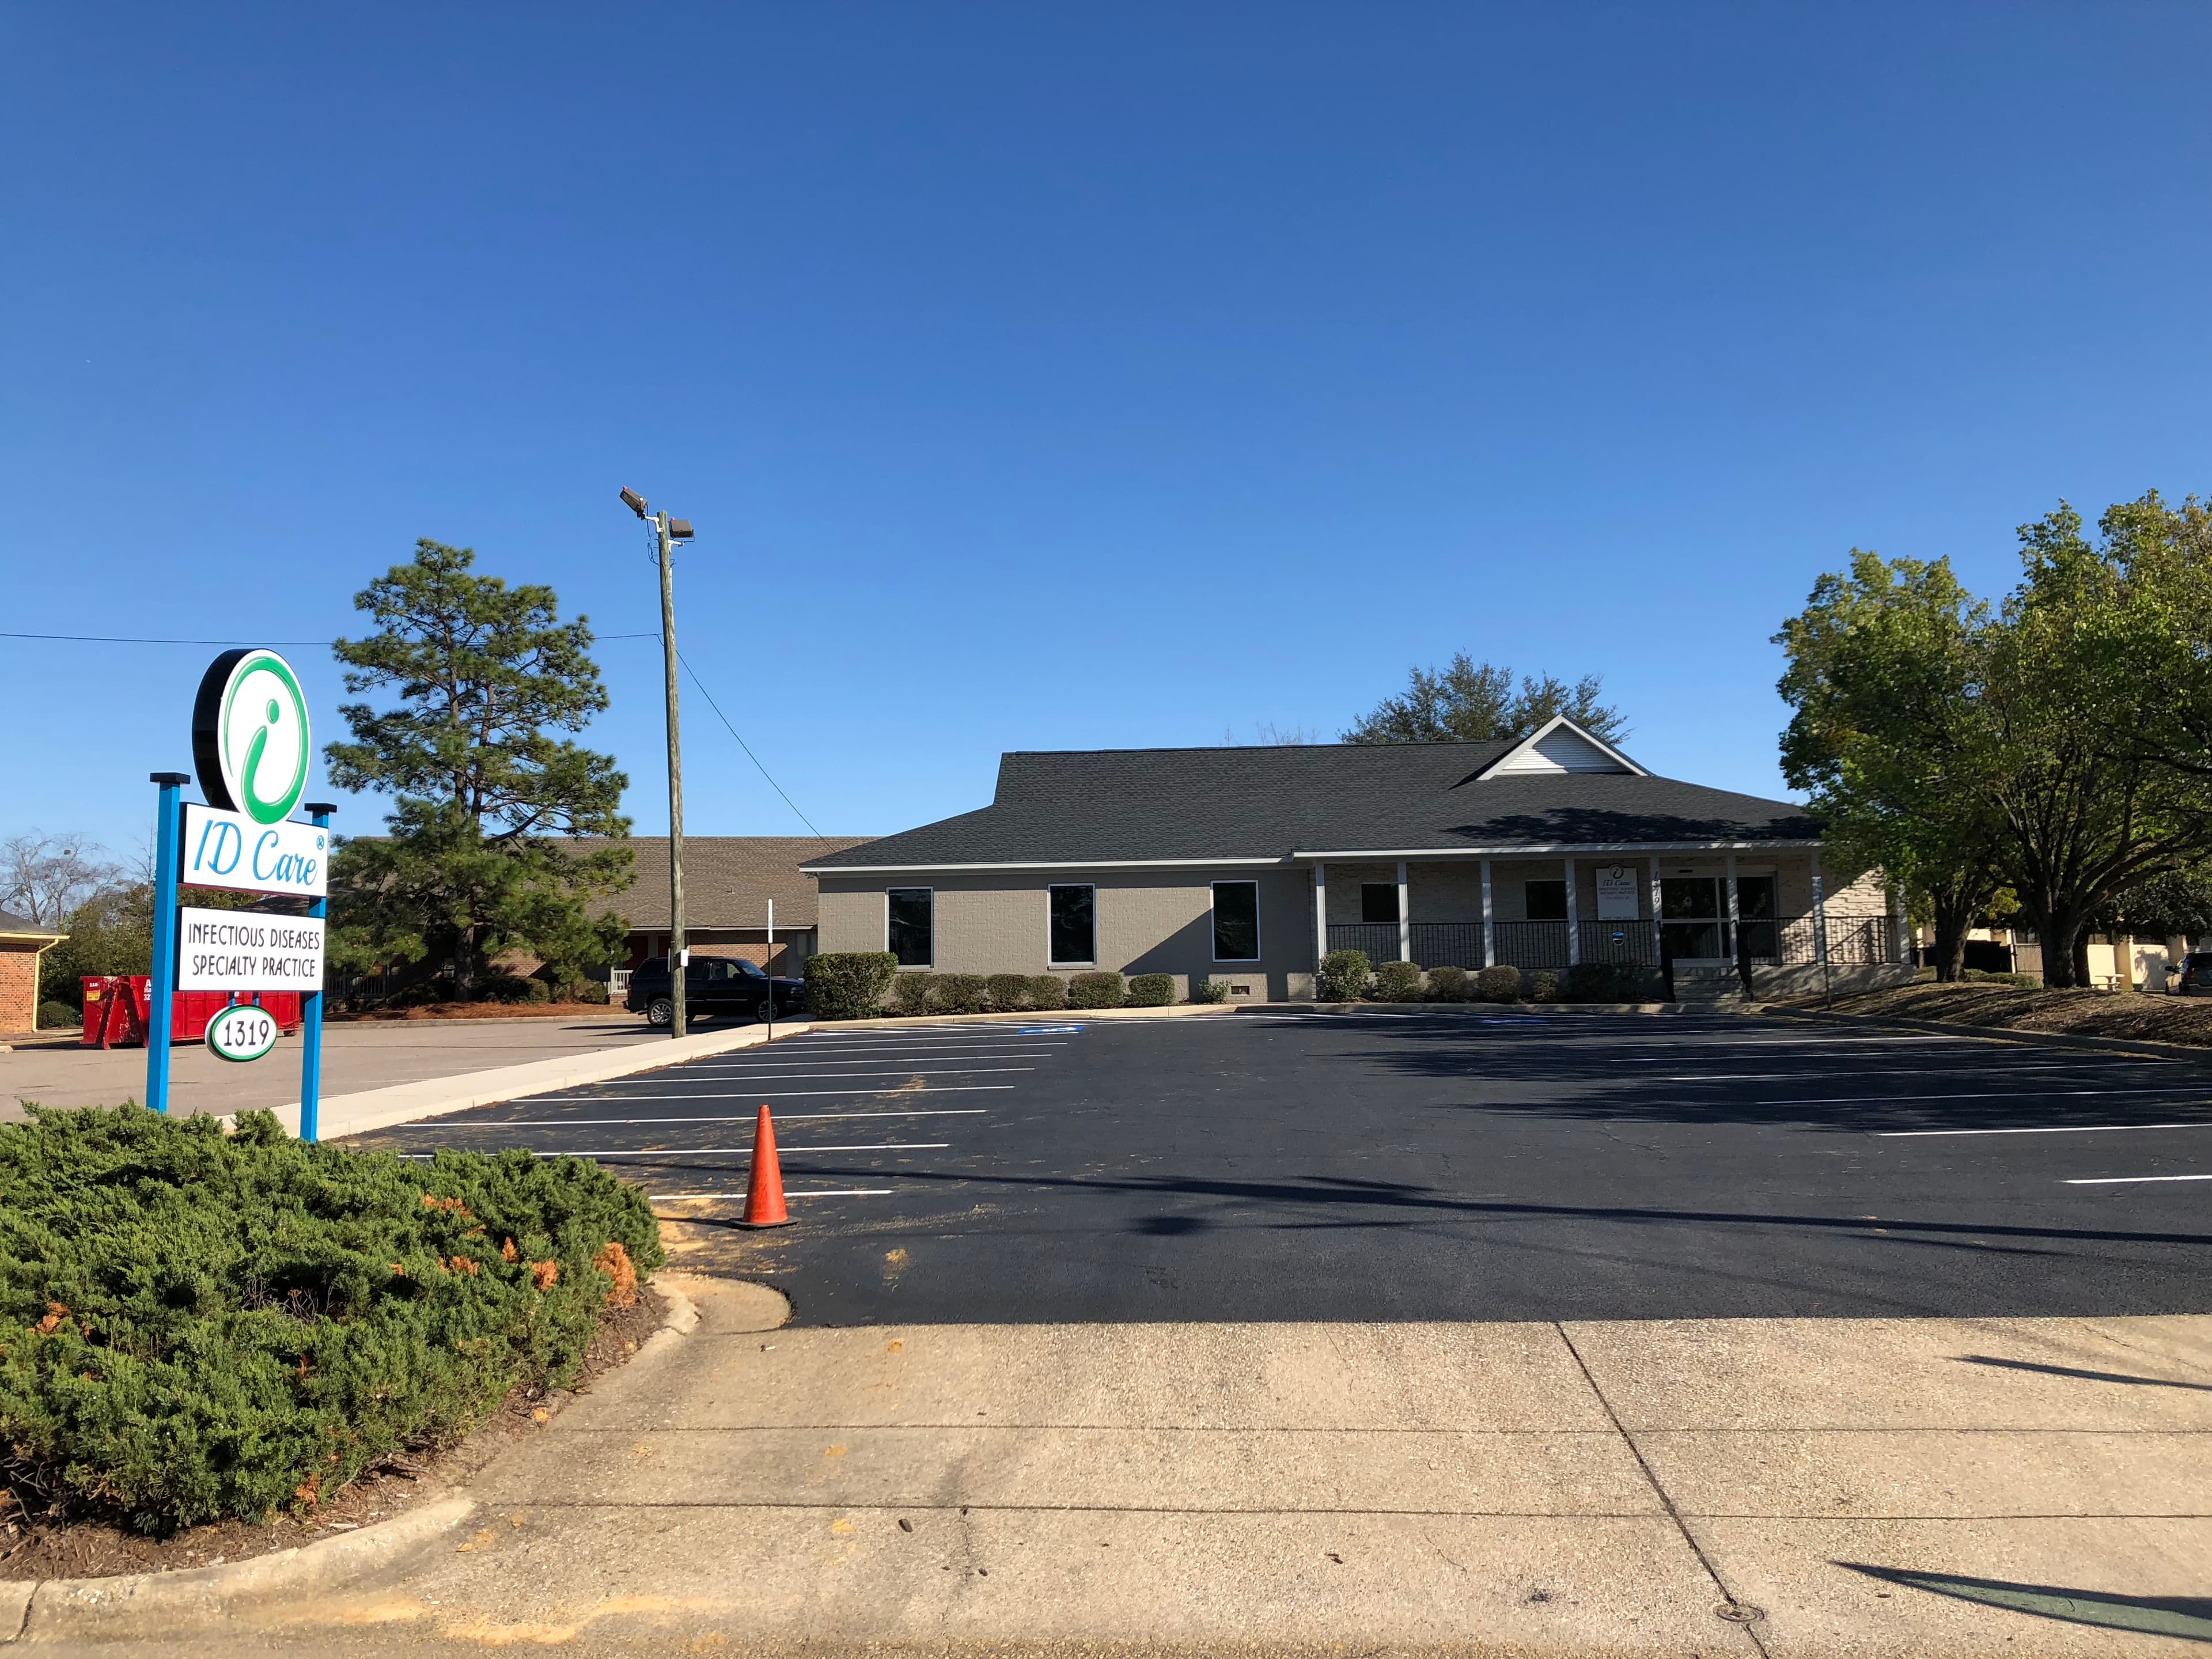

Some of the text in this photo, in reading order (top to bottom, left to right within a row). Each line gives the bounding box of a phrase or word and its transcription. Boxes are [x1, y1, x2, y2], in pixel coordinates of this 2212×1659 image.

[193, 819, 242, 875] ID
[188, 923, 320, 950] INFECTIOUS DISEASES
[192, 955, 316, 978] SPECIALTY PRACTICE
[224, 1020, 269, 1047] 1319
